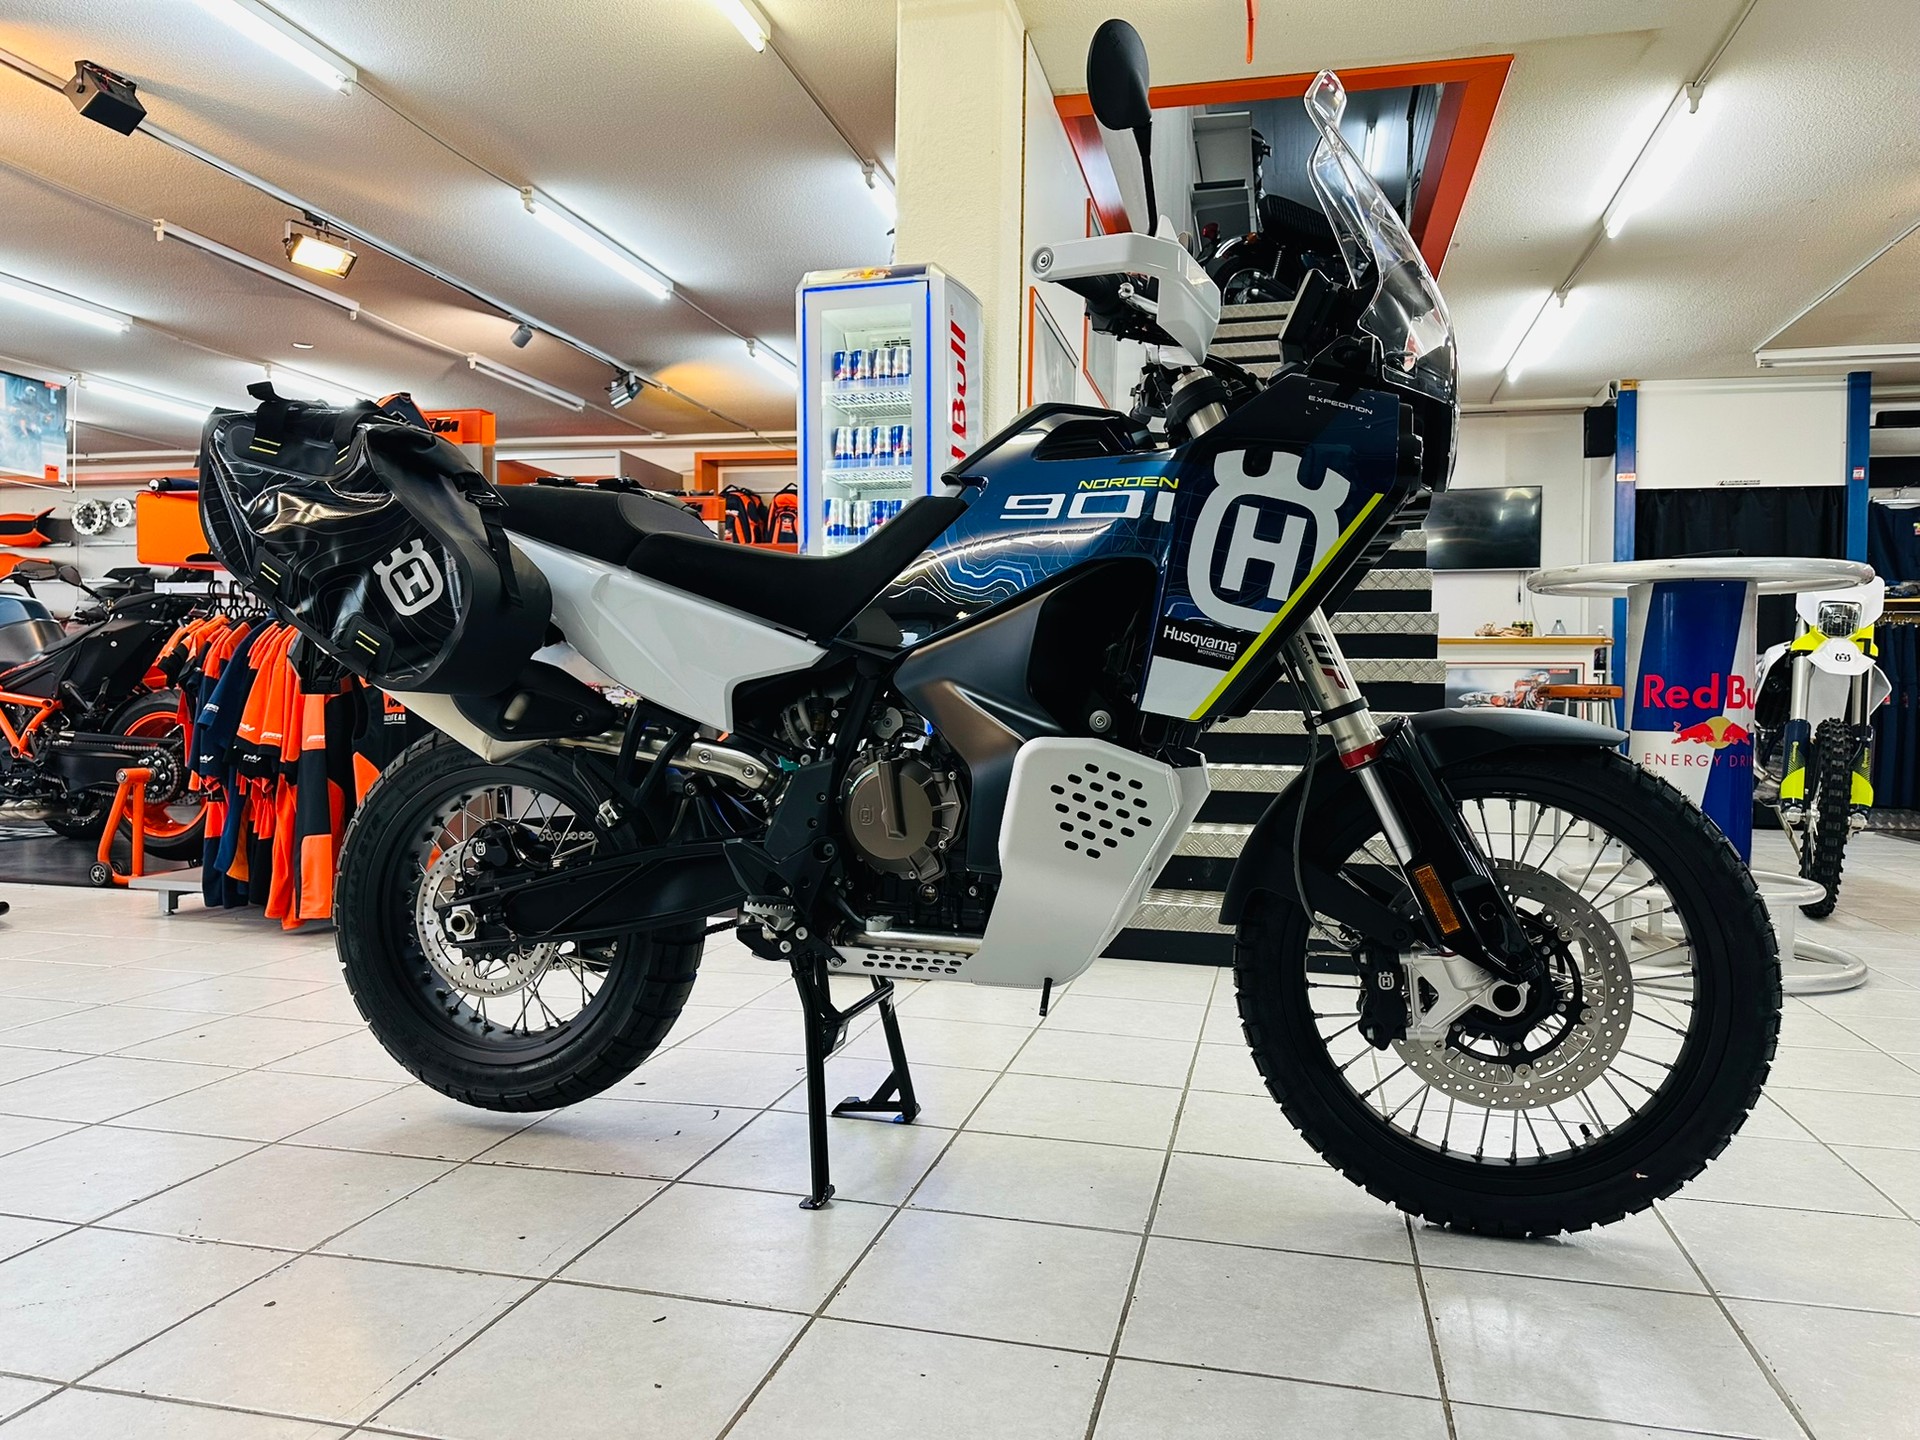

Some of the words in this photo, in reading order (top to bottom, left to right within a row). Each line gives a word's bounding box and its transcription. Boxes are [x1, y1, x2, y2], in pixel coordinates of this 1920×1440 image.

[950, 320, 967, 440] Bull
[1308, 395, 1373, 415] EXPEDITION
[1078, 476, 1180, 490] NORDEN
[1000, 490, 1176, 522] 901
[1163, 625, 1238, 653] Husqvarna
[1197, 649, 1235, 661] MOTORCYCLES
[1643, 673, 1720, 709] Red
[1644, 753, 1722, 767] ENERGY
